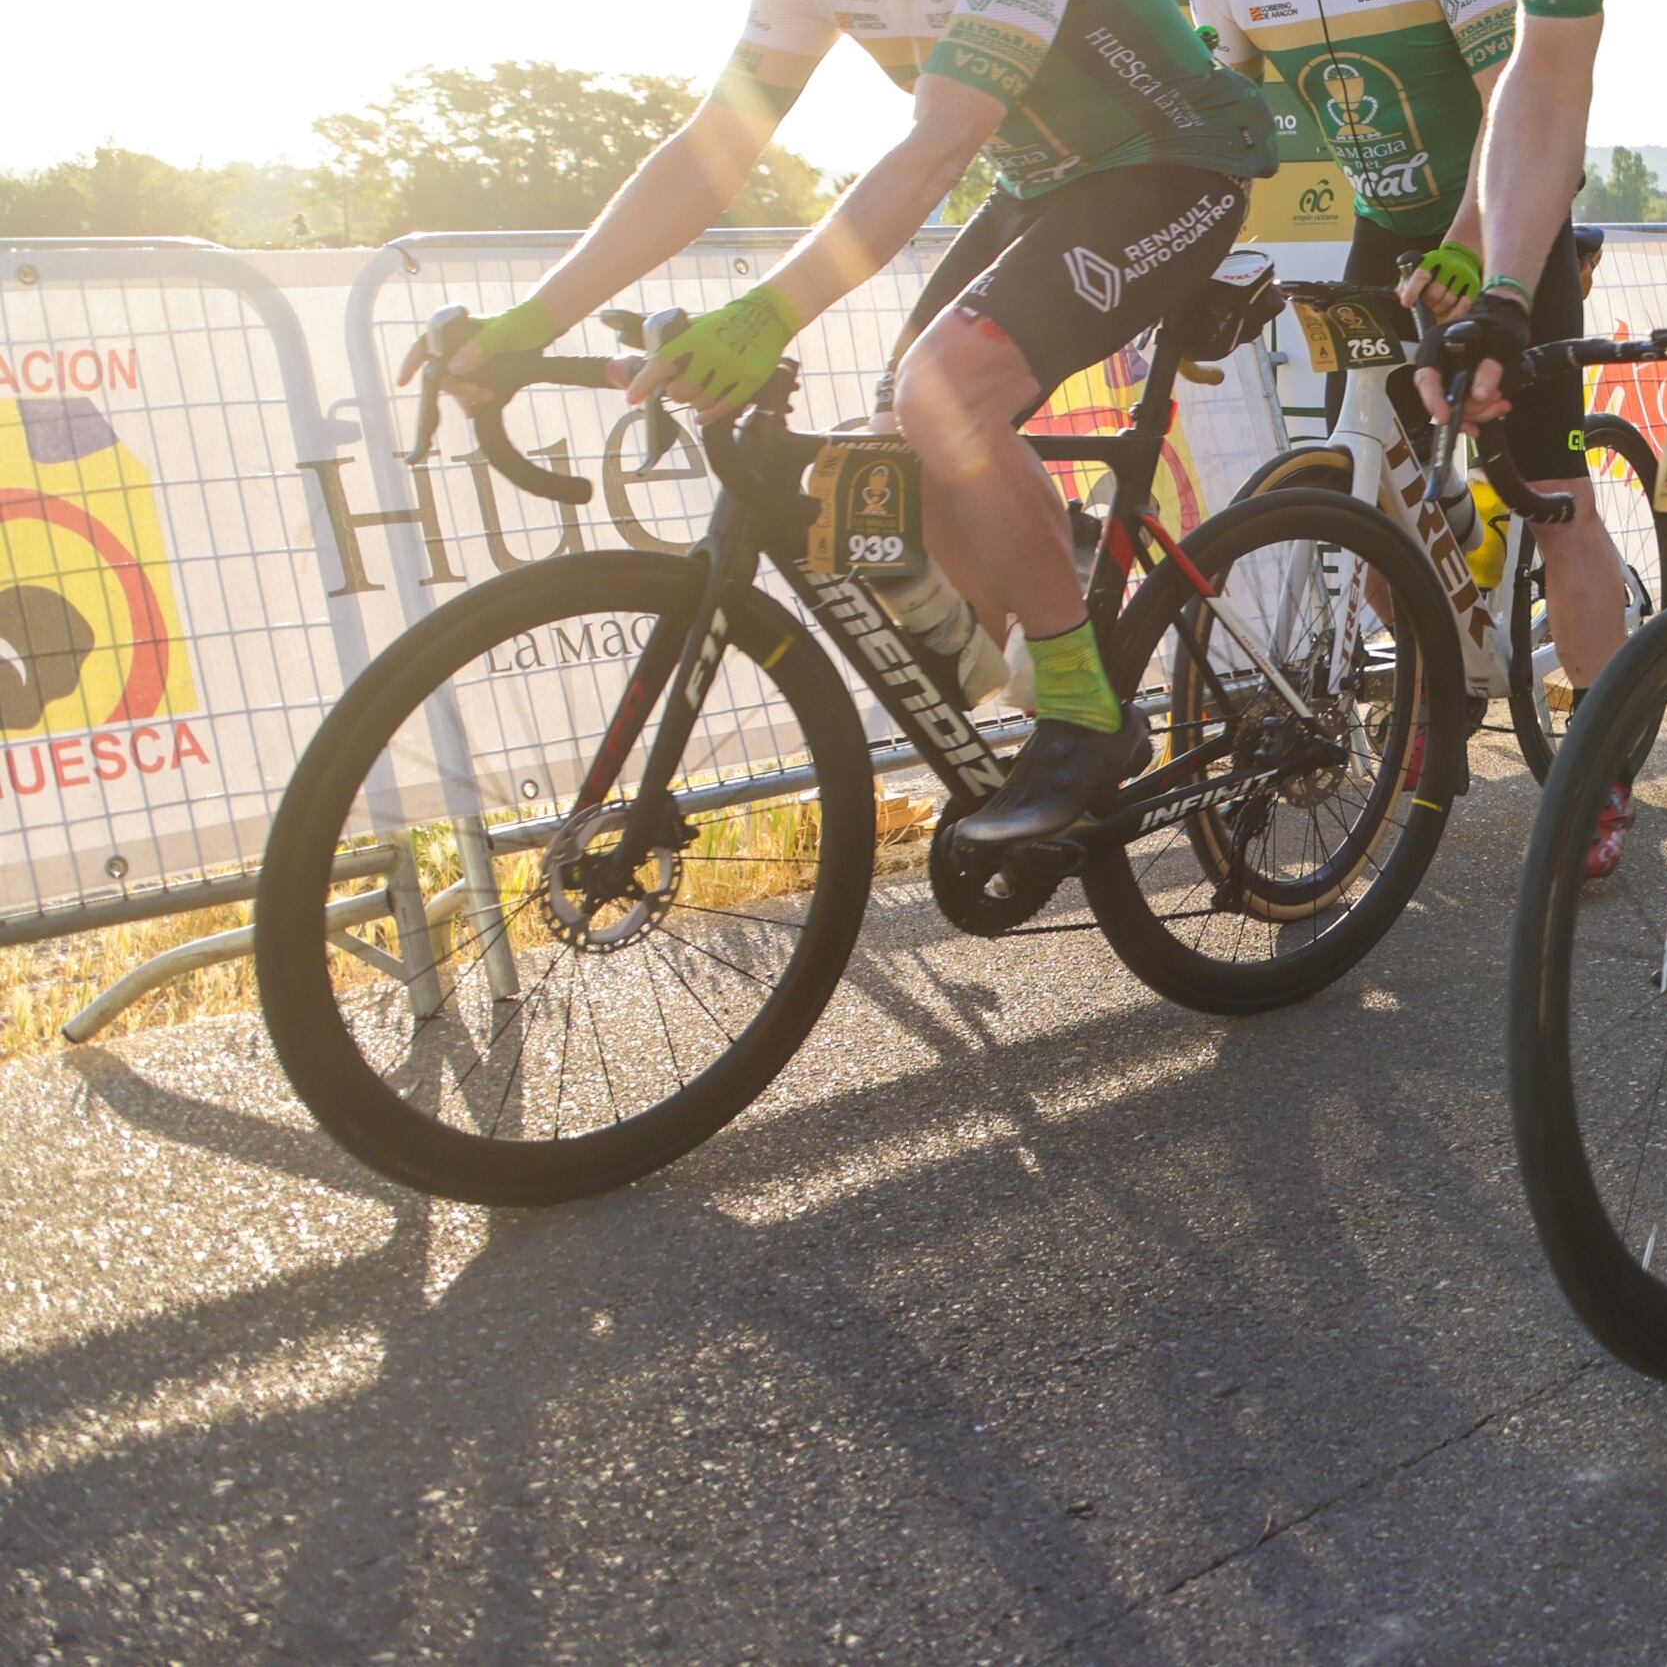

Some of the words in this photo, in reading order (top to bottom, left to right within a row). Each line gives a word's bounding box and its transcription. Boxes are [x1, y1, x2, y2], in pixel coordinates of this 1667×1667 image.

[1123, 194, 1213, 262] RENAULT
[1123, 248, 1172, 283] AUTO
[1173, 194, 1236, 253] CUATRO
[0, 348, 137, 394] ACION
[1348, 338, 1391, 359] 756
[848, 534, 904, 562] 939
[1385, 437, 1496, 650] TREK
[0, 721, 209, 799] UESCA
